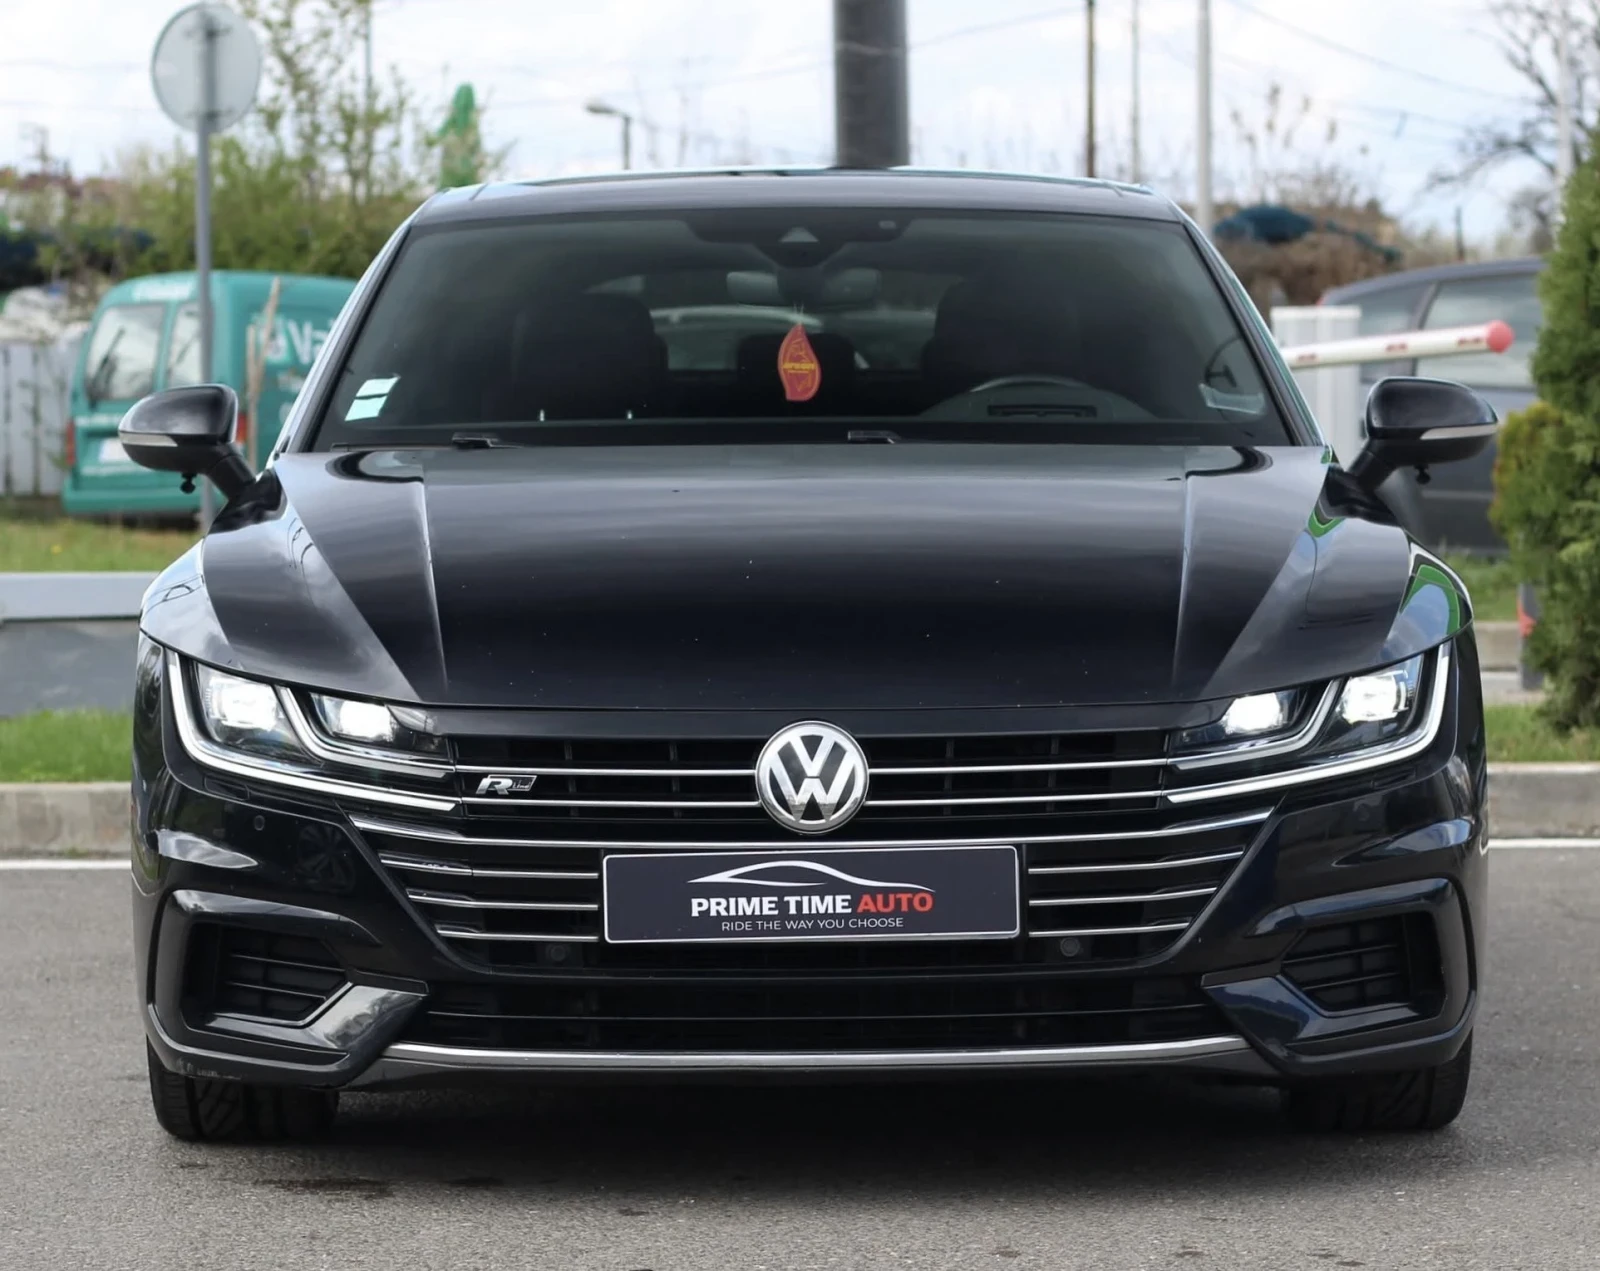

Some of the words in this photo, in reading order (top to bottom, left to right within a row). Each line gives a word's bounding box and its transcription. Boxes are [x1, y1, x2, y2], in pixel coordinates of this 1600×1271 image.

[691, 896, 779, 917] PRIME
[783, 894, 852, 915] TIME
[856, 892, 934, 913] AUTO
[721, 921, 753, 931] RIDE
[756, 920, 781, 930] THE
[784, 919, 815, 929] WAY
[817, 919, 845, 929] YOU
[848, 917, 904, 928] CHOOSE
